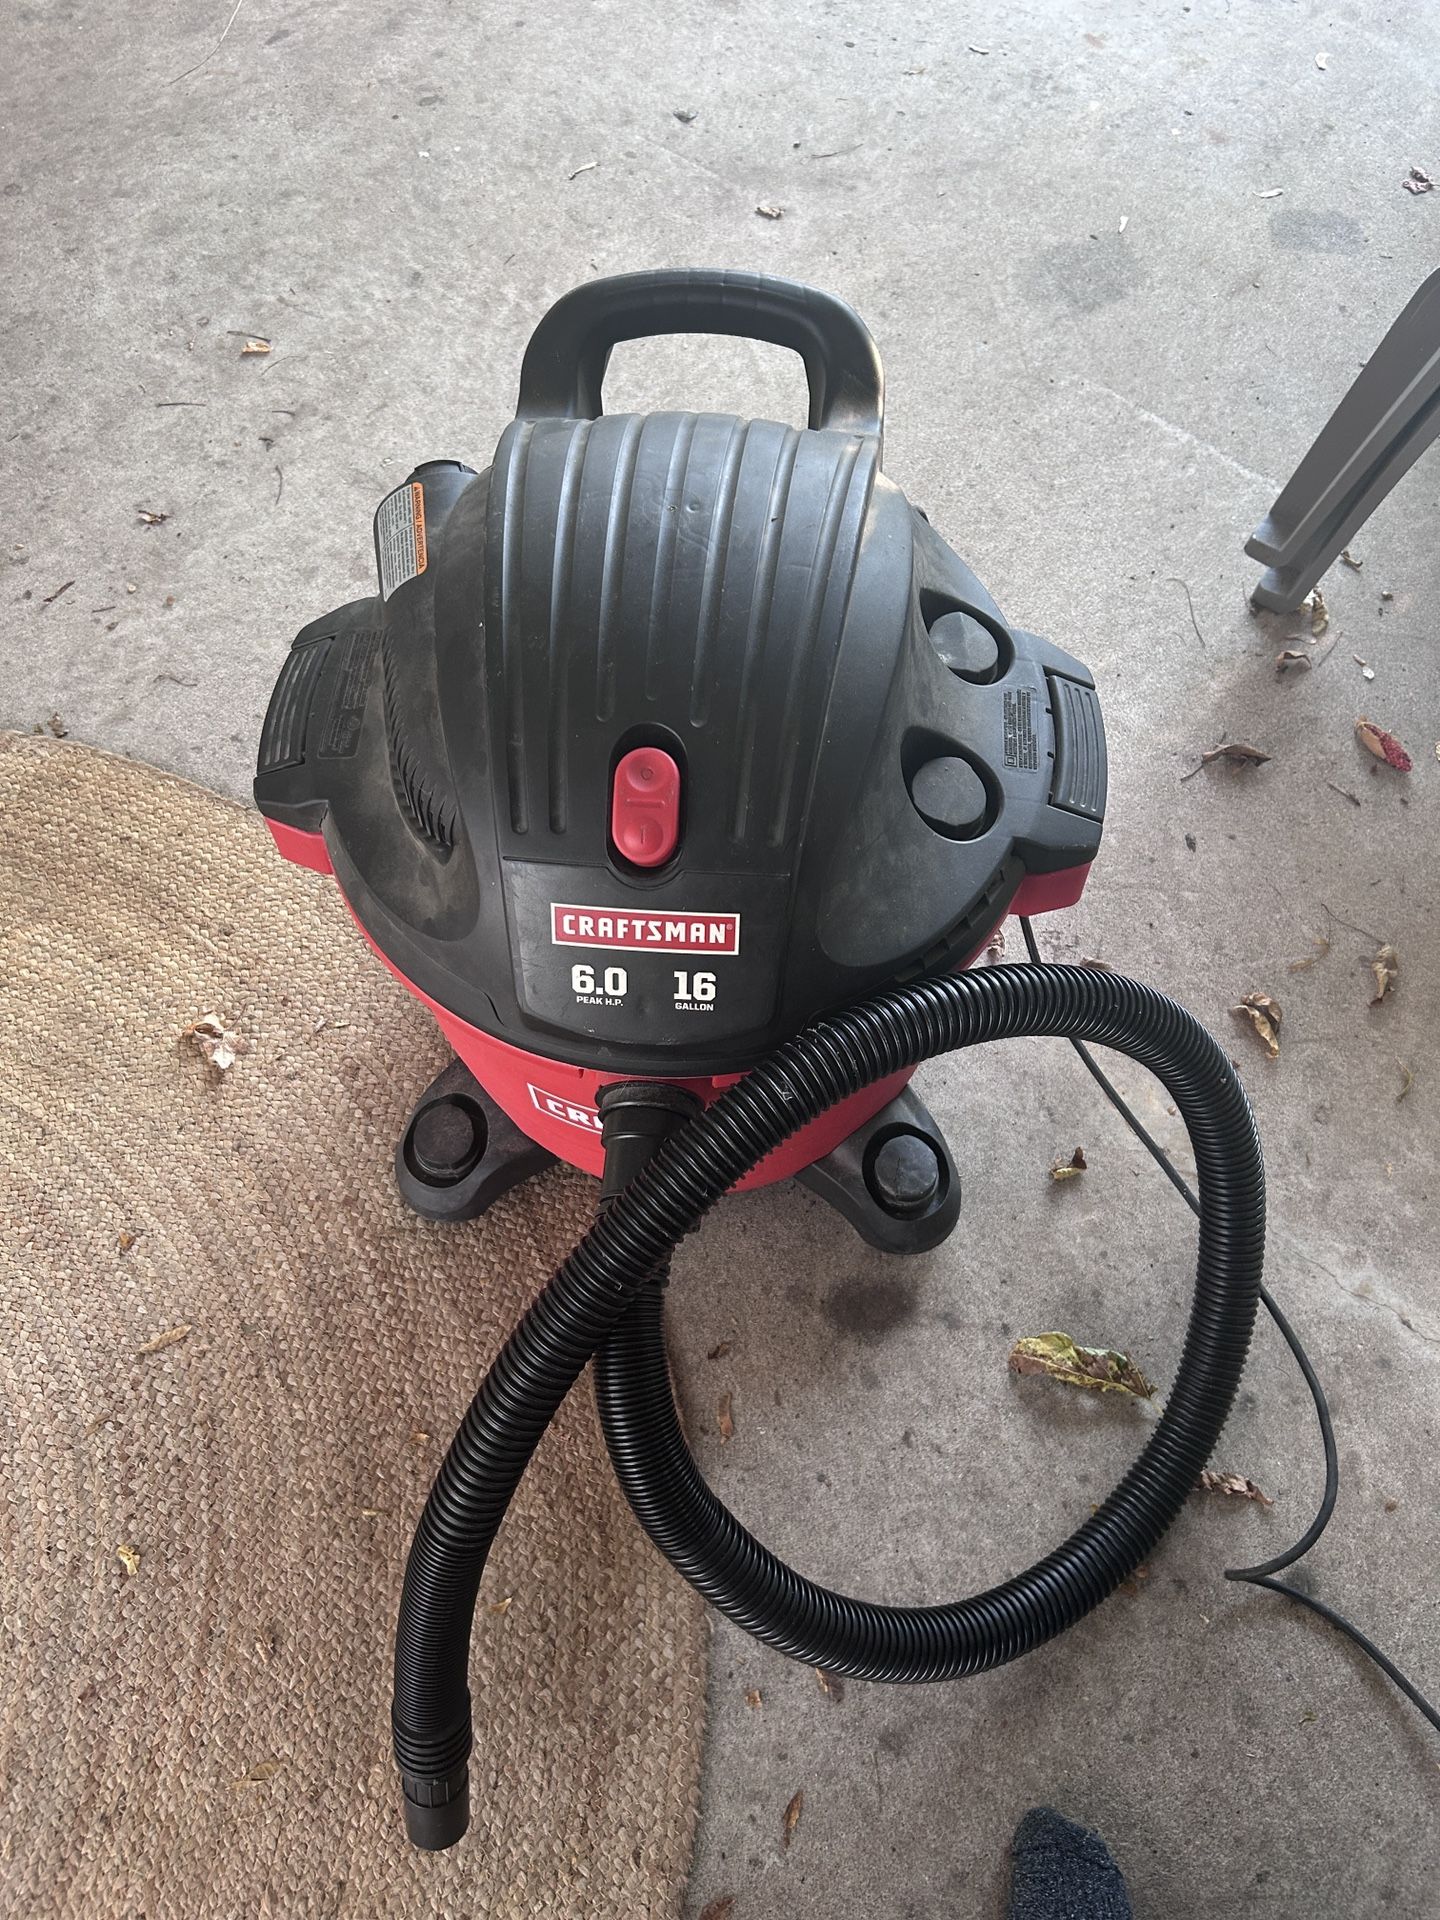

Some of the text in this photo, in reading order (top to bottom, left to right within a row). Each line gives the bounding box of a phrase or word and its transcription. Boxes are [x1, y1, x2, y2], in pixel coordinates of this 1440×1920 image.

[414, 490, 422, 519] WARNING
[416, 524, 425, 570] ADVERTENCIA
[571, 964, 628, 997] 6.0
[673, 971, 717, 1002] 16
[576, 995, 624, 1007] PEAK H.P.
[675, 1002, 714, 1011] GALLON
